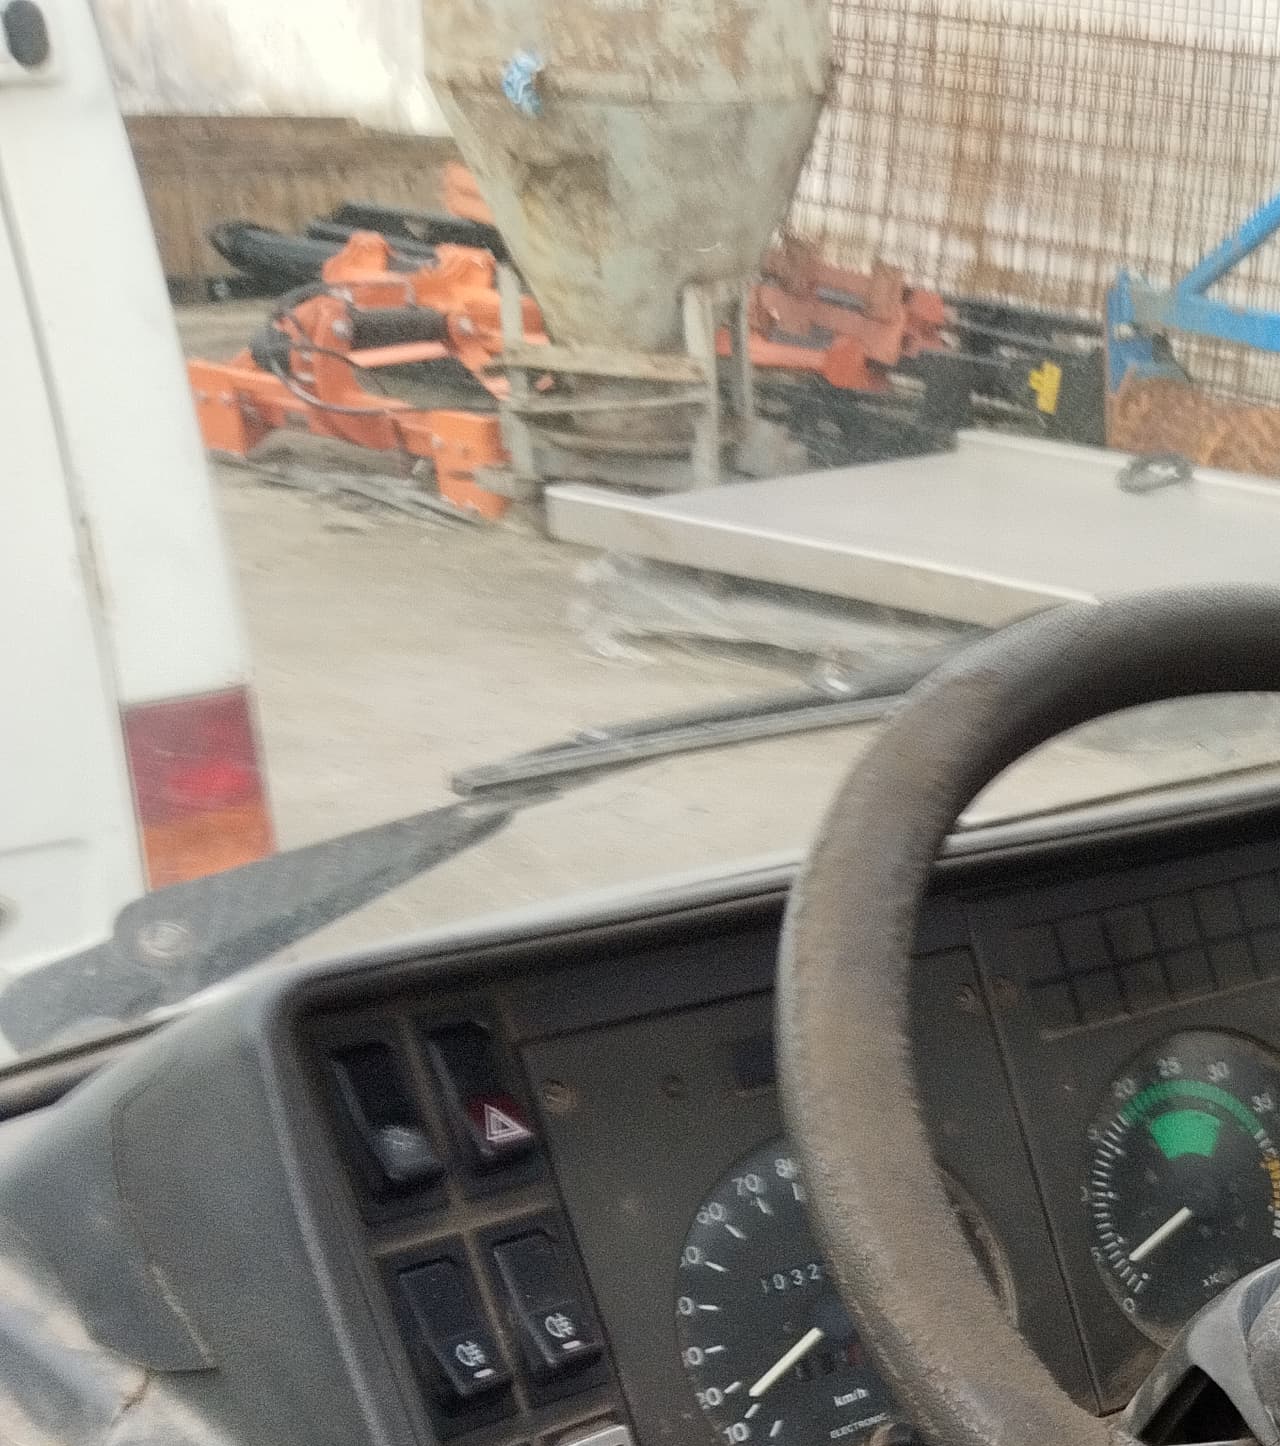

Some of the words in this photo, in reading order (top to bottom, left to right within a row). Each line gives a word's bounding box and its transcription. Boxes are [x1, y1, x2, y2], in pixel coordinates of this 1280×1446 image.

[1123, 1297, 1136, 1314] 0
[833, 1388, 869, 1407] km/h
[723, 1422, 750, 1444] 10
